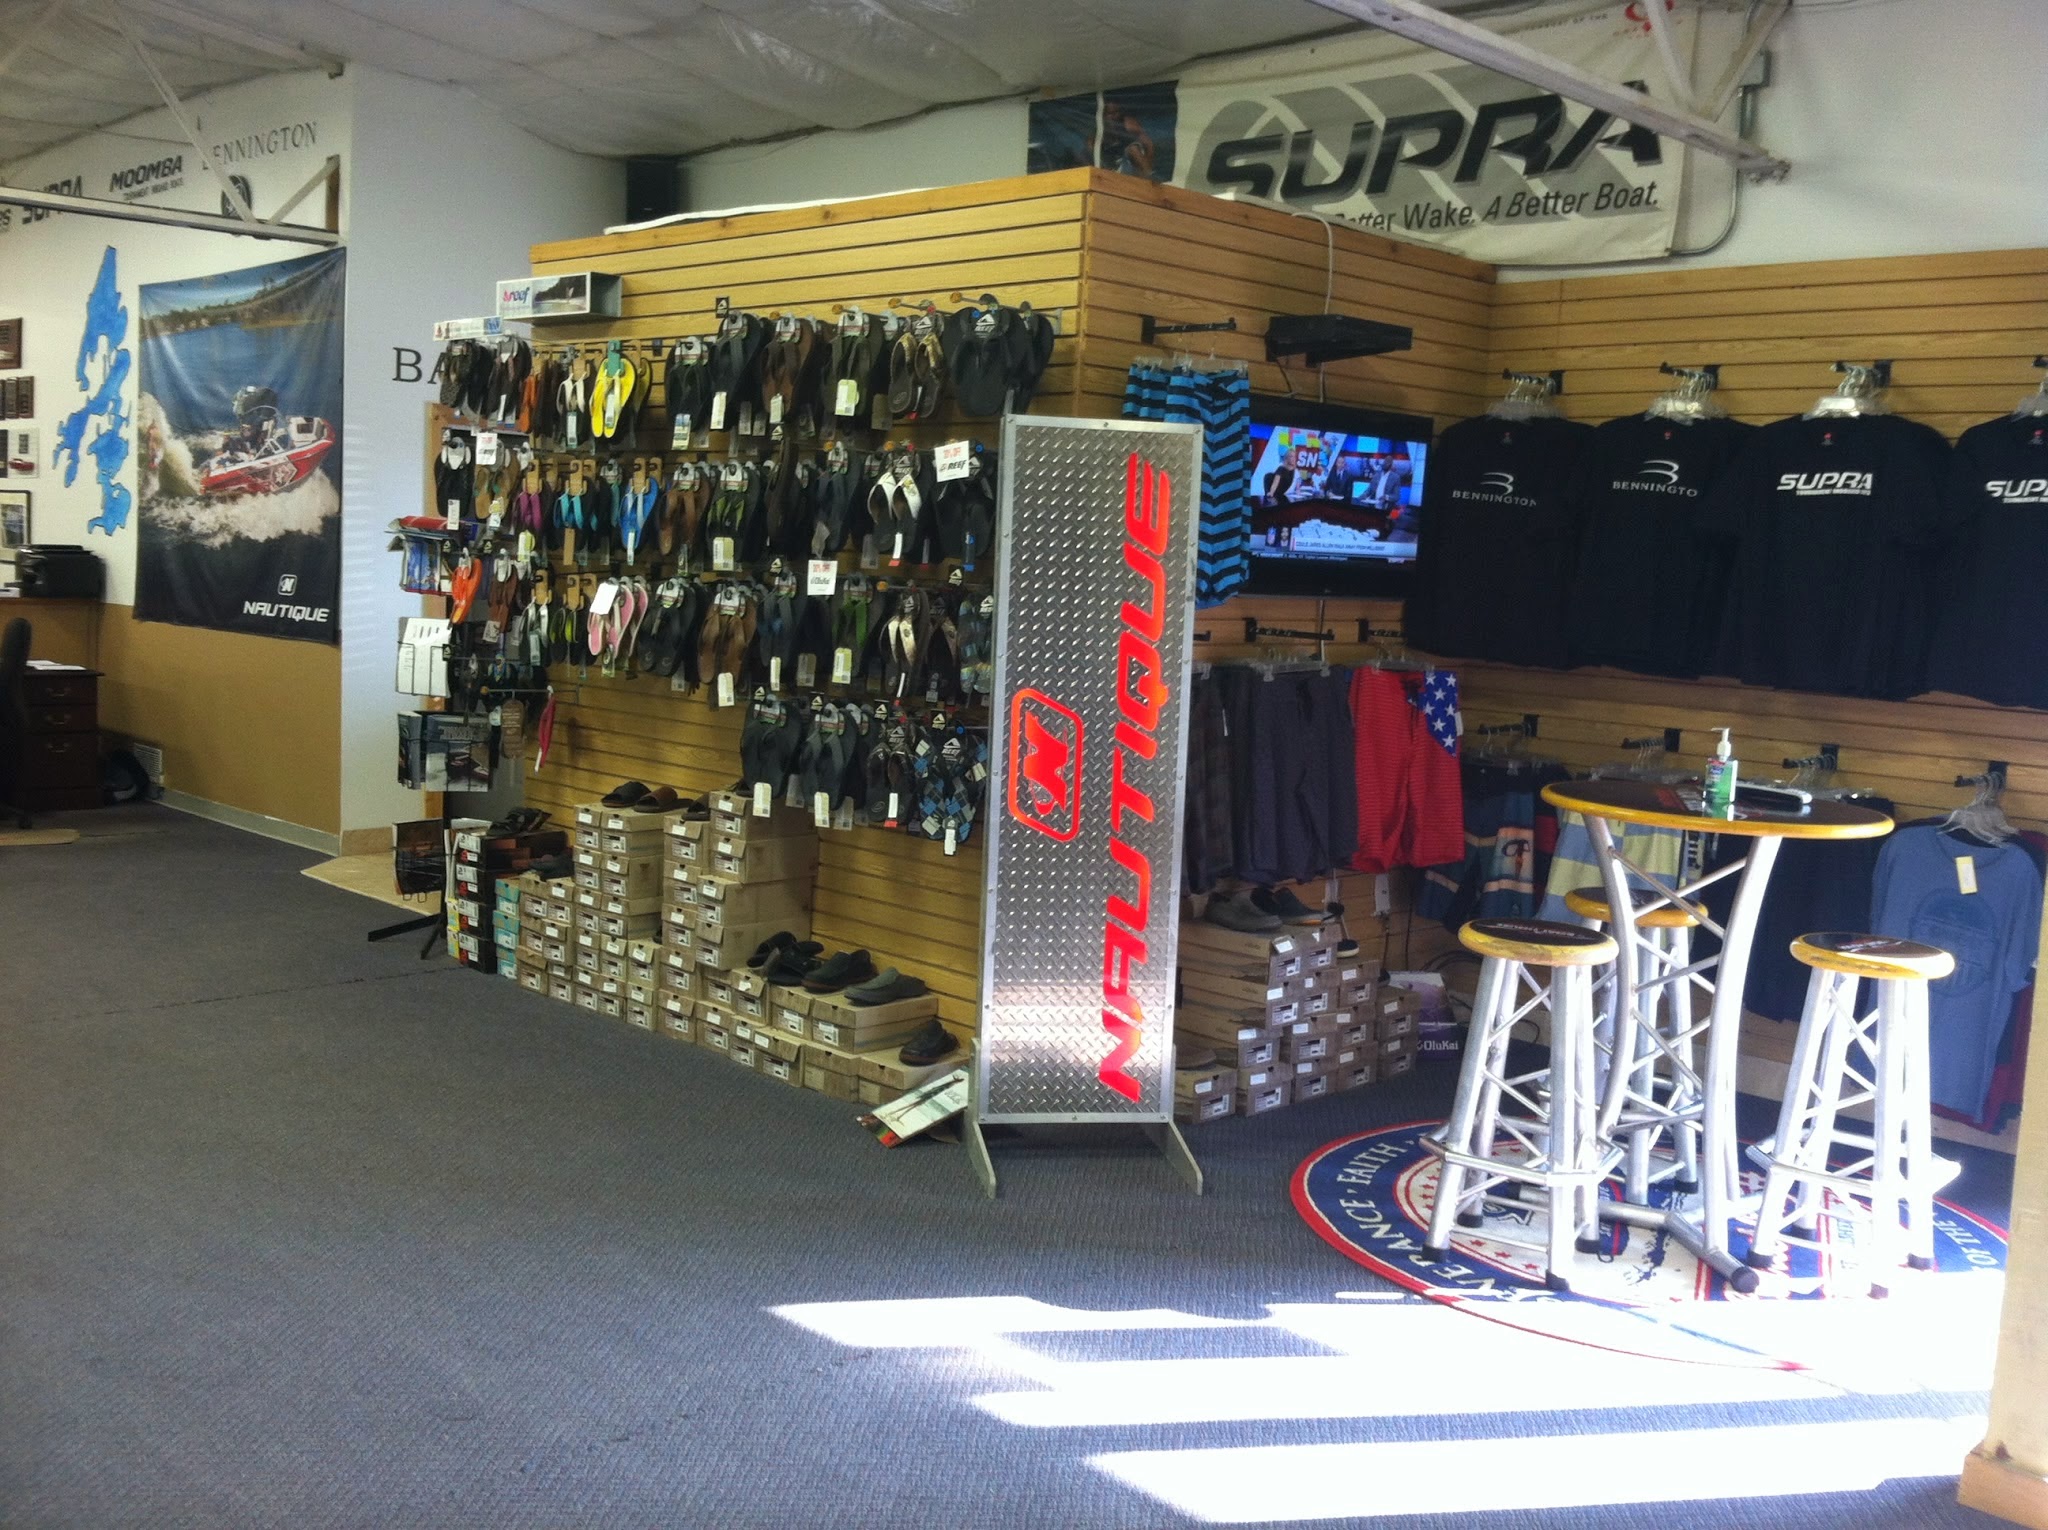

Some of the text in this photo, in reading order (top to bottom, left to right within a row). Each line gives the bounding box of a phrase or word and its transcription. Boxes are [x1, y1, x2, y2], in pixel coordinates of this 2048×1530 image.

[1207, 79, 1662, 197] SUPRA
[109, 155, 183, 193] MOOMBA
[1404, 202, 1475, 231] Wake.
[1482, 195, 1501, 223] A
[1506, 191, 1588, 219] Better
[1594, 181, 1659, 211] Boat.
[1777, 471, 1873, 491] SUPRA
[243, 601, 330, 622] NAUTIQUE
[1099, 452, 1171, 1103] NAUTIQUE
[1423, 1040, 1459, 1051] OluKai
[1336, 1142, 1408, 1185] FAITH
